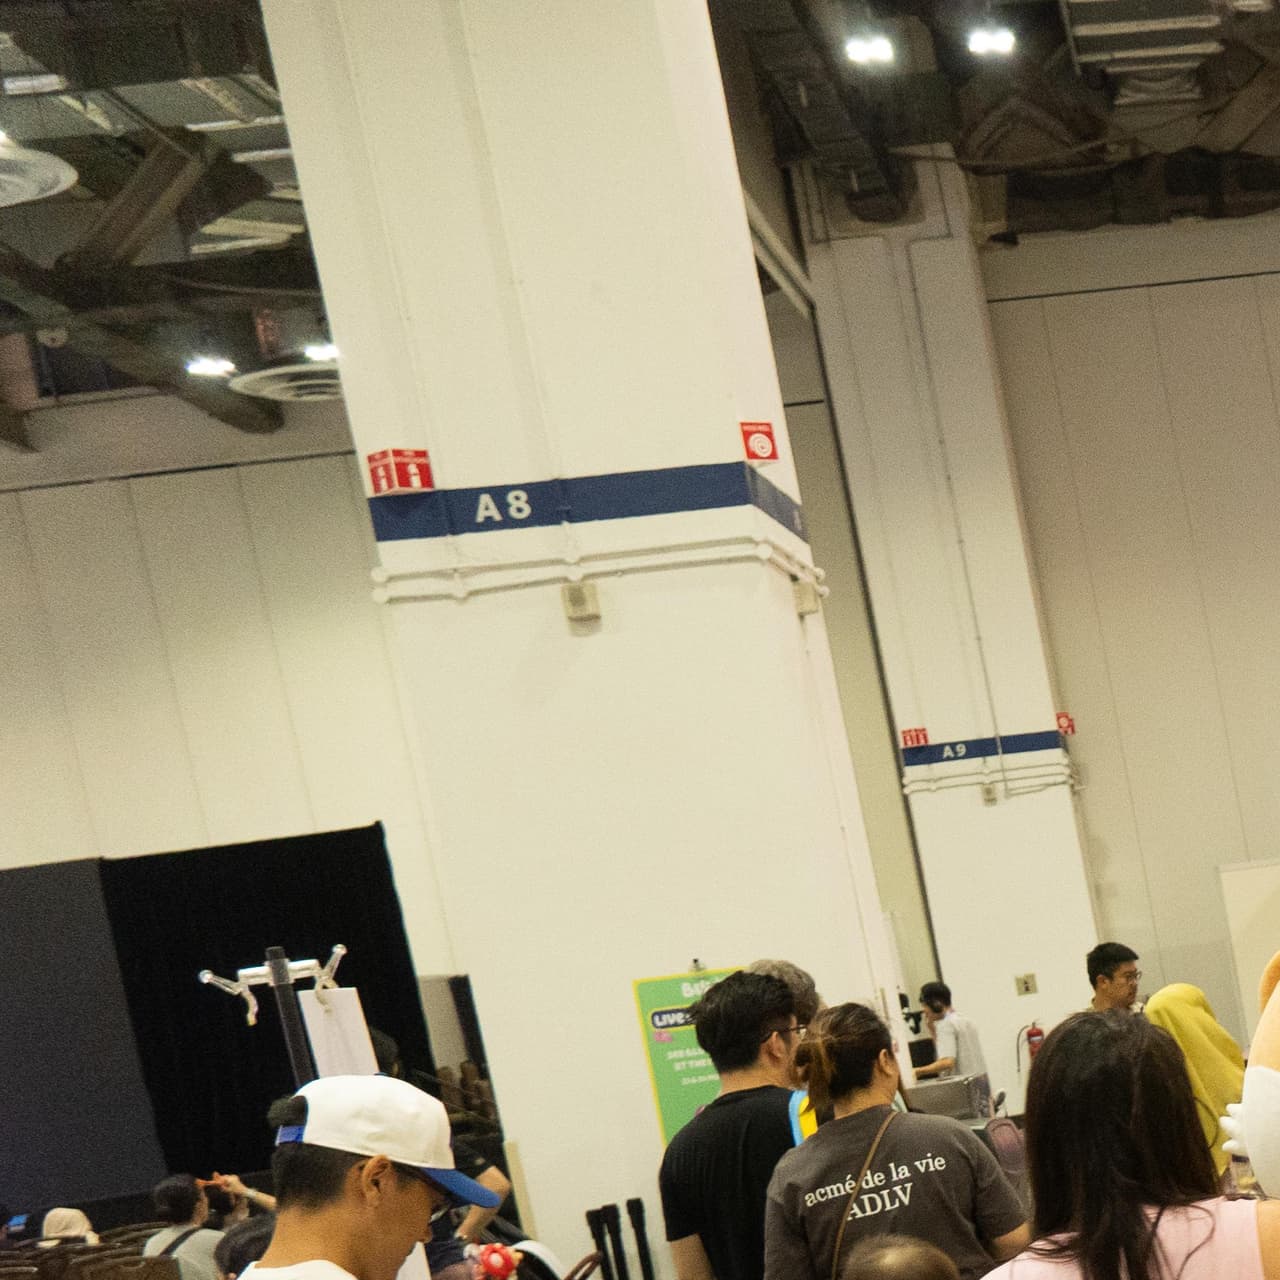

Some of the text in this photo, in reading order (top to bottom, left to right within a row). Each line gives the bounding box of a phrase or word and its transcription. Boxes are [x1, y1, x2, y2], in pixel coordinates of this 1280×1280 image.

[475, 489, 532, 523] A8
[943, 743, 967, 760] A9
[804, 1152, 947, 1207] acmé de la vie
[846, 1182, 913, 1221] ADLV
